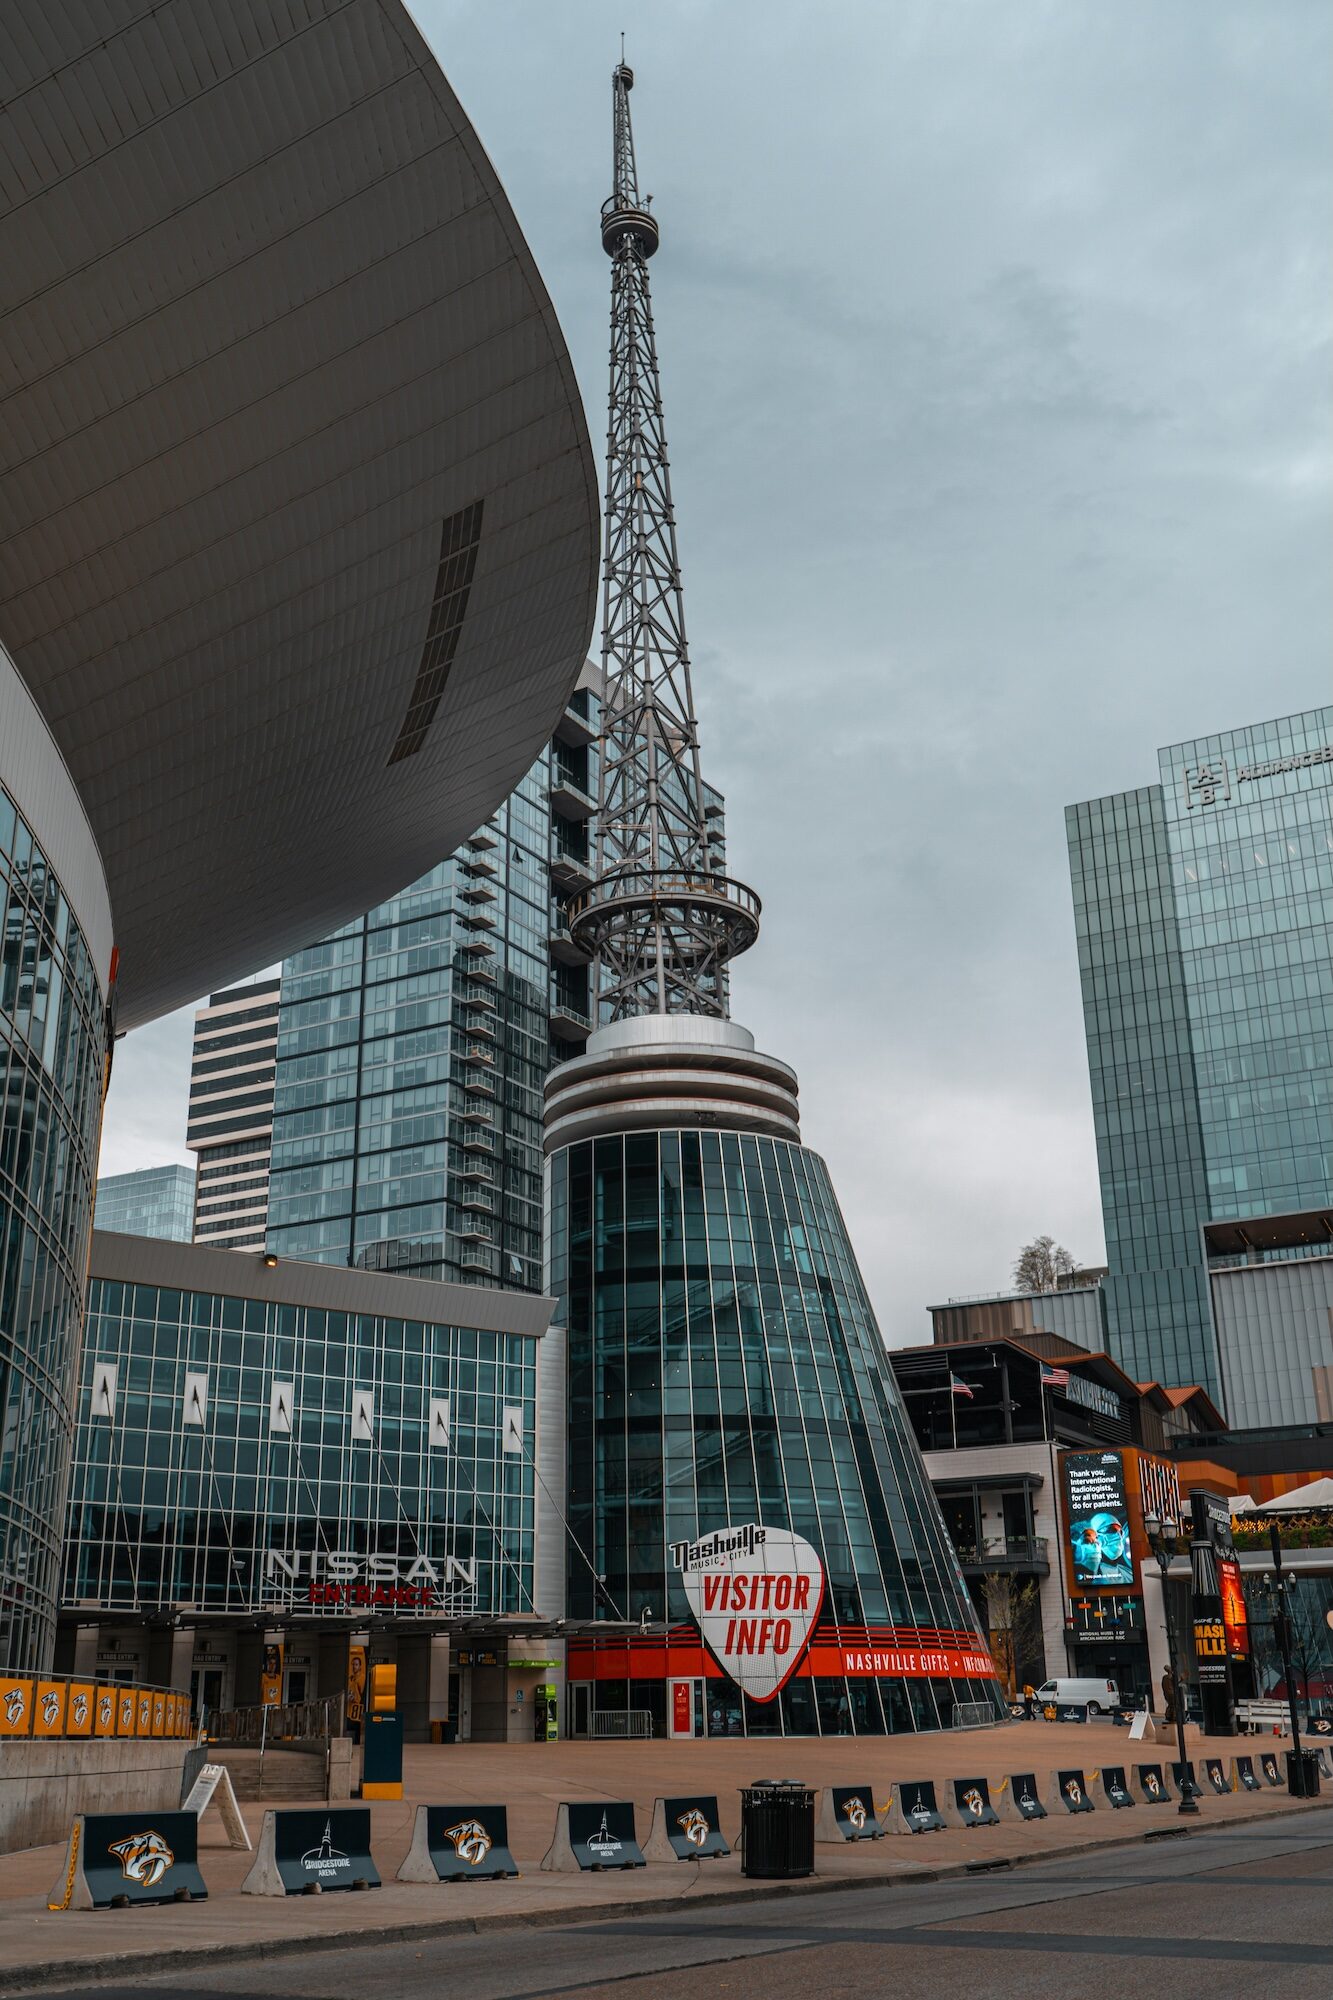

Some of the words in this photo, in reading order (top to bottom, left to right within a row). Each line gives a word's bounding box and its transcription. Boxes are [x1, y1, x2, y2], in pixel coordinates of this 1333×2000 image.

[1069, 1470, 1090, 1478] Thank
[1090, 1470, 1106, 1478] you,
[1070, 1475, 1116, 1485] Interventional
[1071, 1485, 1114, 1494] Radiologists,
[1093, 1500, 1123, 1509] patients.
[267, 1549, 475, 1583] NISSAN
[690, 1557, 720, 1571] MUSIC
[729, 1550, 748, 1561] CITY
[308, 1583, 434, 1606] ENTRANCE
[704, 1575, 810, 1611] VISITOR
[724, 1618, 792, 1655] INFO
[846, 1653, 916, 1671] NASHVILLE
[921, 1654, 949, 1671] GIFTS
[304, 1858, 351, 1869] BRIDGESTONE
